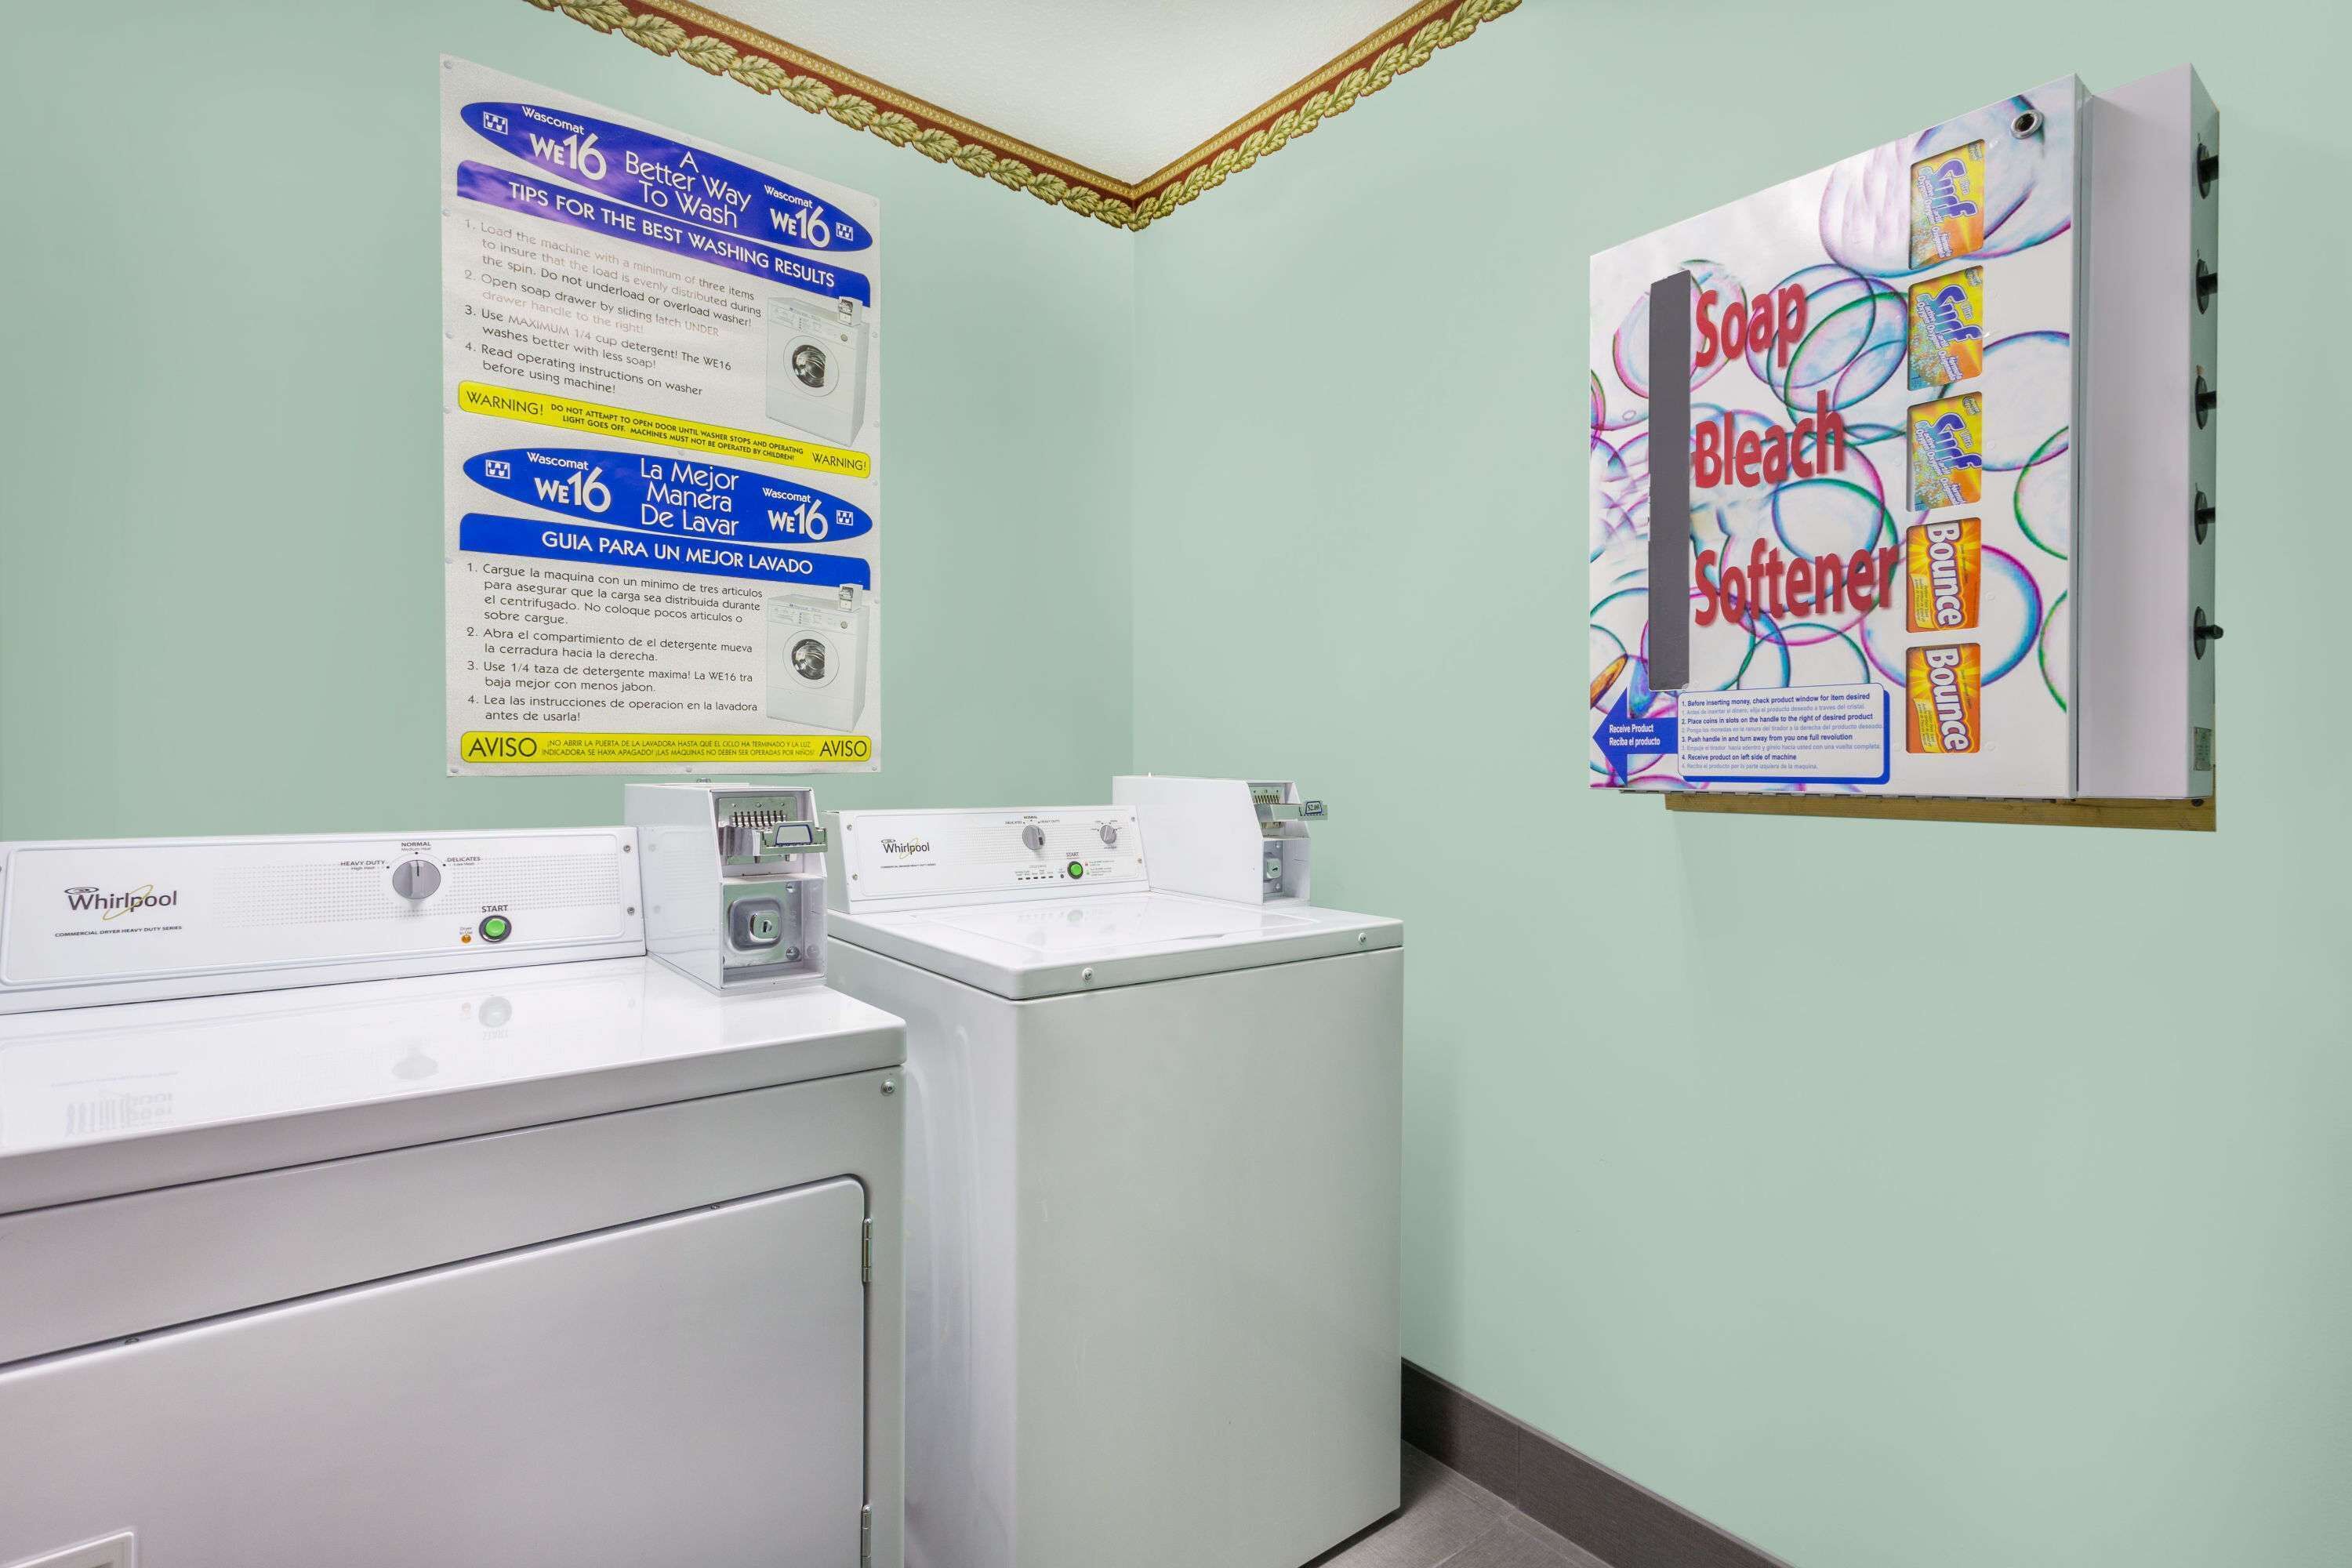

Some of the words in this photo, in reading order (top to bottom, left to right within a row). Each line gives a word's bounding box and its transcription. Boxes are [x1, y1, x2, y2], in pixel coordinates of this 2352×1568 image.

[521, 106, 584, 136] Wascomat
[530, 132, 607, 181] WE16
[679, 151, 699, 173] A
[626, 151, 697, 192] Better
[702, 175, 752, 212] Way
[764, 184, 812, 209] Wascomat
[1918, 158, 1977, 218] Surf
[638, 179, 668, 208] To
[675, 190, 737, 228] Wash
[509, 182, 548, 207] TIPS
[557, 195, 595, 220] FOR
[601, 208, 636, 231] THE
[642, 220, 683, 244] BEST
[688, 232, 769, 268] WASHING
[775, 257, 834, 288] RESULTS
[770, 206, 830, 248] WE16
[482, 256, 503, 267] the
[507, 262, 536, 275] spin.
[541, 267, 557, 281] Do
[561, 274, 582, 287] not
[586, 281, 644, 301] underload
[648, 296, 660, 305] or
[663, 299, 710, 318] overload
[713, 312, 751, 326] washer!
[1695, 282, 1806, 368] Soap
[1916, 284, 1983, 342] Surf
[1961, 302, 1973, 320] Ultra
[482, 326, 528, 343] washes
[532, 335, 570, 350] better
[573, 345, 599, 357] with
[603, 349, 622, 362] less
[626, 356, 655, 369] soap!
[465, 342, 476, 351] 4.
[481, 343, 513, 359] Read
[517, 353, 575, 372] operating
[579, 365, 644, 384] instructions
[647, 379, 662, 387] on
[665, 382, 703, 395] washer
[483, 360, 524, 377] before
[529, 371, 560, 385] using
[564, 377, 615, 394] machine!
[466, 390, 543, 416] WARNING!
[566, 407, 583, 416] NOT
[586, 411, 618, 422] ATTEMPT
[620, 416, 631, 424] TO
[633, 419, 653, 427] OPEN
[655, 423, 677, 432] DOOR
[679, 426, 699, 436] UNTIL
[700, 430, 728, 441] WASHER
[730, 435, 751, 445] STOPS
[768, 442, 804, 455] OPERATING
[1695, 389, 1845, 488] Bleach
[1915, 412, 1982, 469] Surf
[1960, 430, 1973, 448] Ultra
[527, 452, 589, 470] Wascomat
[641, 457, 662, 481] La
[671, 461, 739, 492] Mejor
[812, 452, 866, 471] WARNING!
[534, 466, 612, 513] WE16
[647, 481, 731, 513] Manera
[762, 488, 811, 503] Wascomat
[641, 503, 673, 528] De
[683, 509, 739, 536] Lavar
[768, 499, 828, 540] WE16
[542, 531, 593, 552] GUIA
[599, 537, 648, 557] PARA
[655, 543, 680, 561] UN
[686, 547, 743, 568] MEJOR
[749, 554, 813, 575] LAVADO
[467, 562, 477, 572] 1.
[483, 563, 525, 577] Cargue
[530, 568, 540, 578] la
[544, 571, 594, 583] maquina
[597, 576, 619, 585] con
[641, 579, 679, 590] minimo
[682, 583, 696, 592] de
[699, 584, 719, 594] tres
[721, 587, 763, 598] articulos
[1694, 537, 1899, 626] Softener
[1926, 522, 1962, 626] Bounce
[466, 626, 478, 637] 2.
[483, 628, 514, 639] Abra
[517, 630, 528, 640] el
[533, 633, 625, 645] compartimiento
[628, 637, 643, 647] de
[646, 638, 656, 647] el
[659, 639, 717, 652] detergente
[720, 644, 753, 653] mueva
[485, 643, 495, 653] la
[499, 646, 558, 656] cerradura
[562, 647, 593, 658] hacia
[597, 649, 605, 659] la
[609, 650, 658, 661] derecha.
[467, 695, 478, 704] 4.
[484, 695, 506, 705] Lea
[510, 695, 525, 706] las
[530, 696, 606, 708] instrucciones
[610, 699, 625, 708] de
[628, 700, 684, 710] operacion
[703, 701, 712, 710] la
[716, 702, 757, 711] lavadora
[485, 711, 518, 720] antes
[523, 711, 539, 720] de
[543, 712, 580, 721] usarla!
[1925, 648, 1969, 751] Bounce
[1609, 724, 1631, 733] Receive
[1632, 724, 1653, 732] Product
[1609, 737, 1628, 746] Reciba
[1628, 737, 1634, 746] el
[1635, 737, 1661, 748] producto
[468, 737, 537, 757] AVISO
[819, 740, 867, 757] AVISO
[883, 842, 930, 855] Whirlpool
[67, 891, 177, 912] Whirlpool
